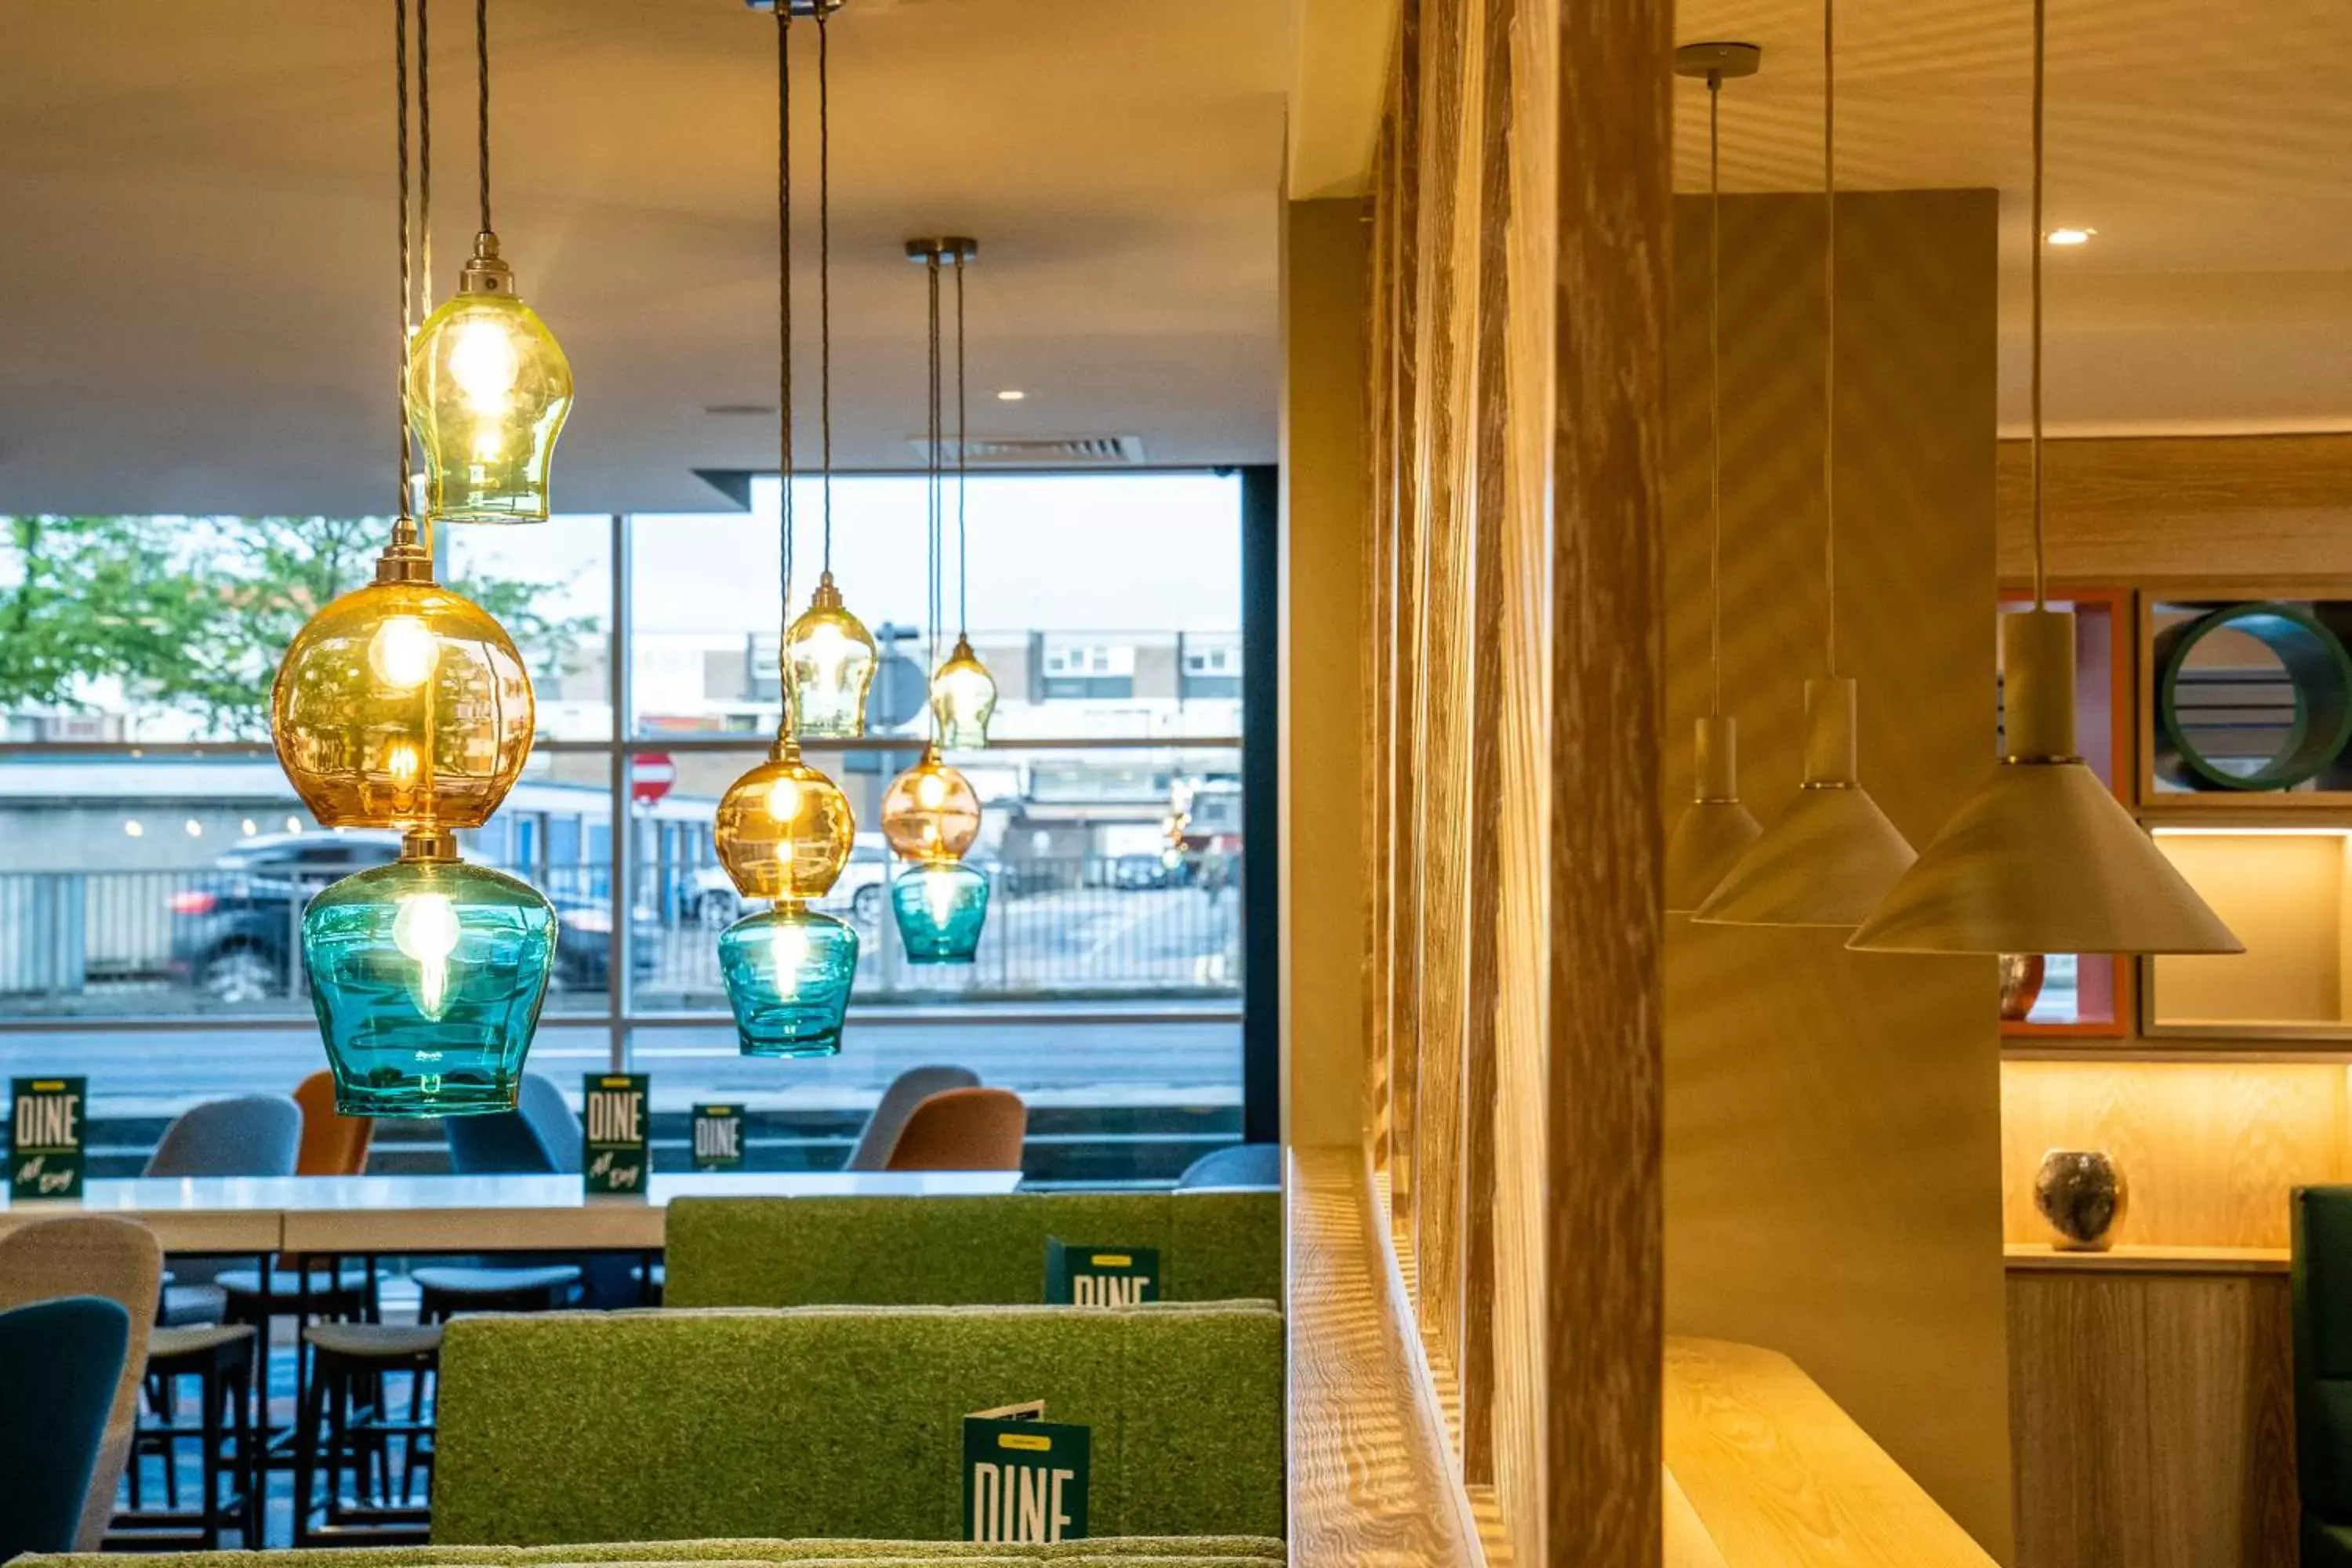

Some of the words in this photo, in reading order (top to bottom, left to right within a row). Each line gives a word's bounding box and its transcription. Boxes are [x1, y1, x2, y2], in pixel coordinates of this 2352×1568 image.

[16, 1095, 79, 1146] DINE
[589, 1092, 643, 1142] DINE
[695, 1118, 740, 1157] DINE
[975, 1462, 1074, 1543] DINE
